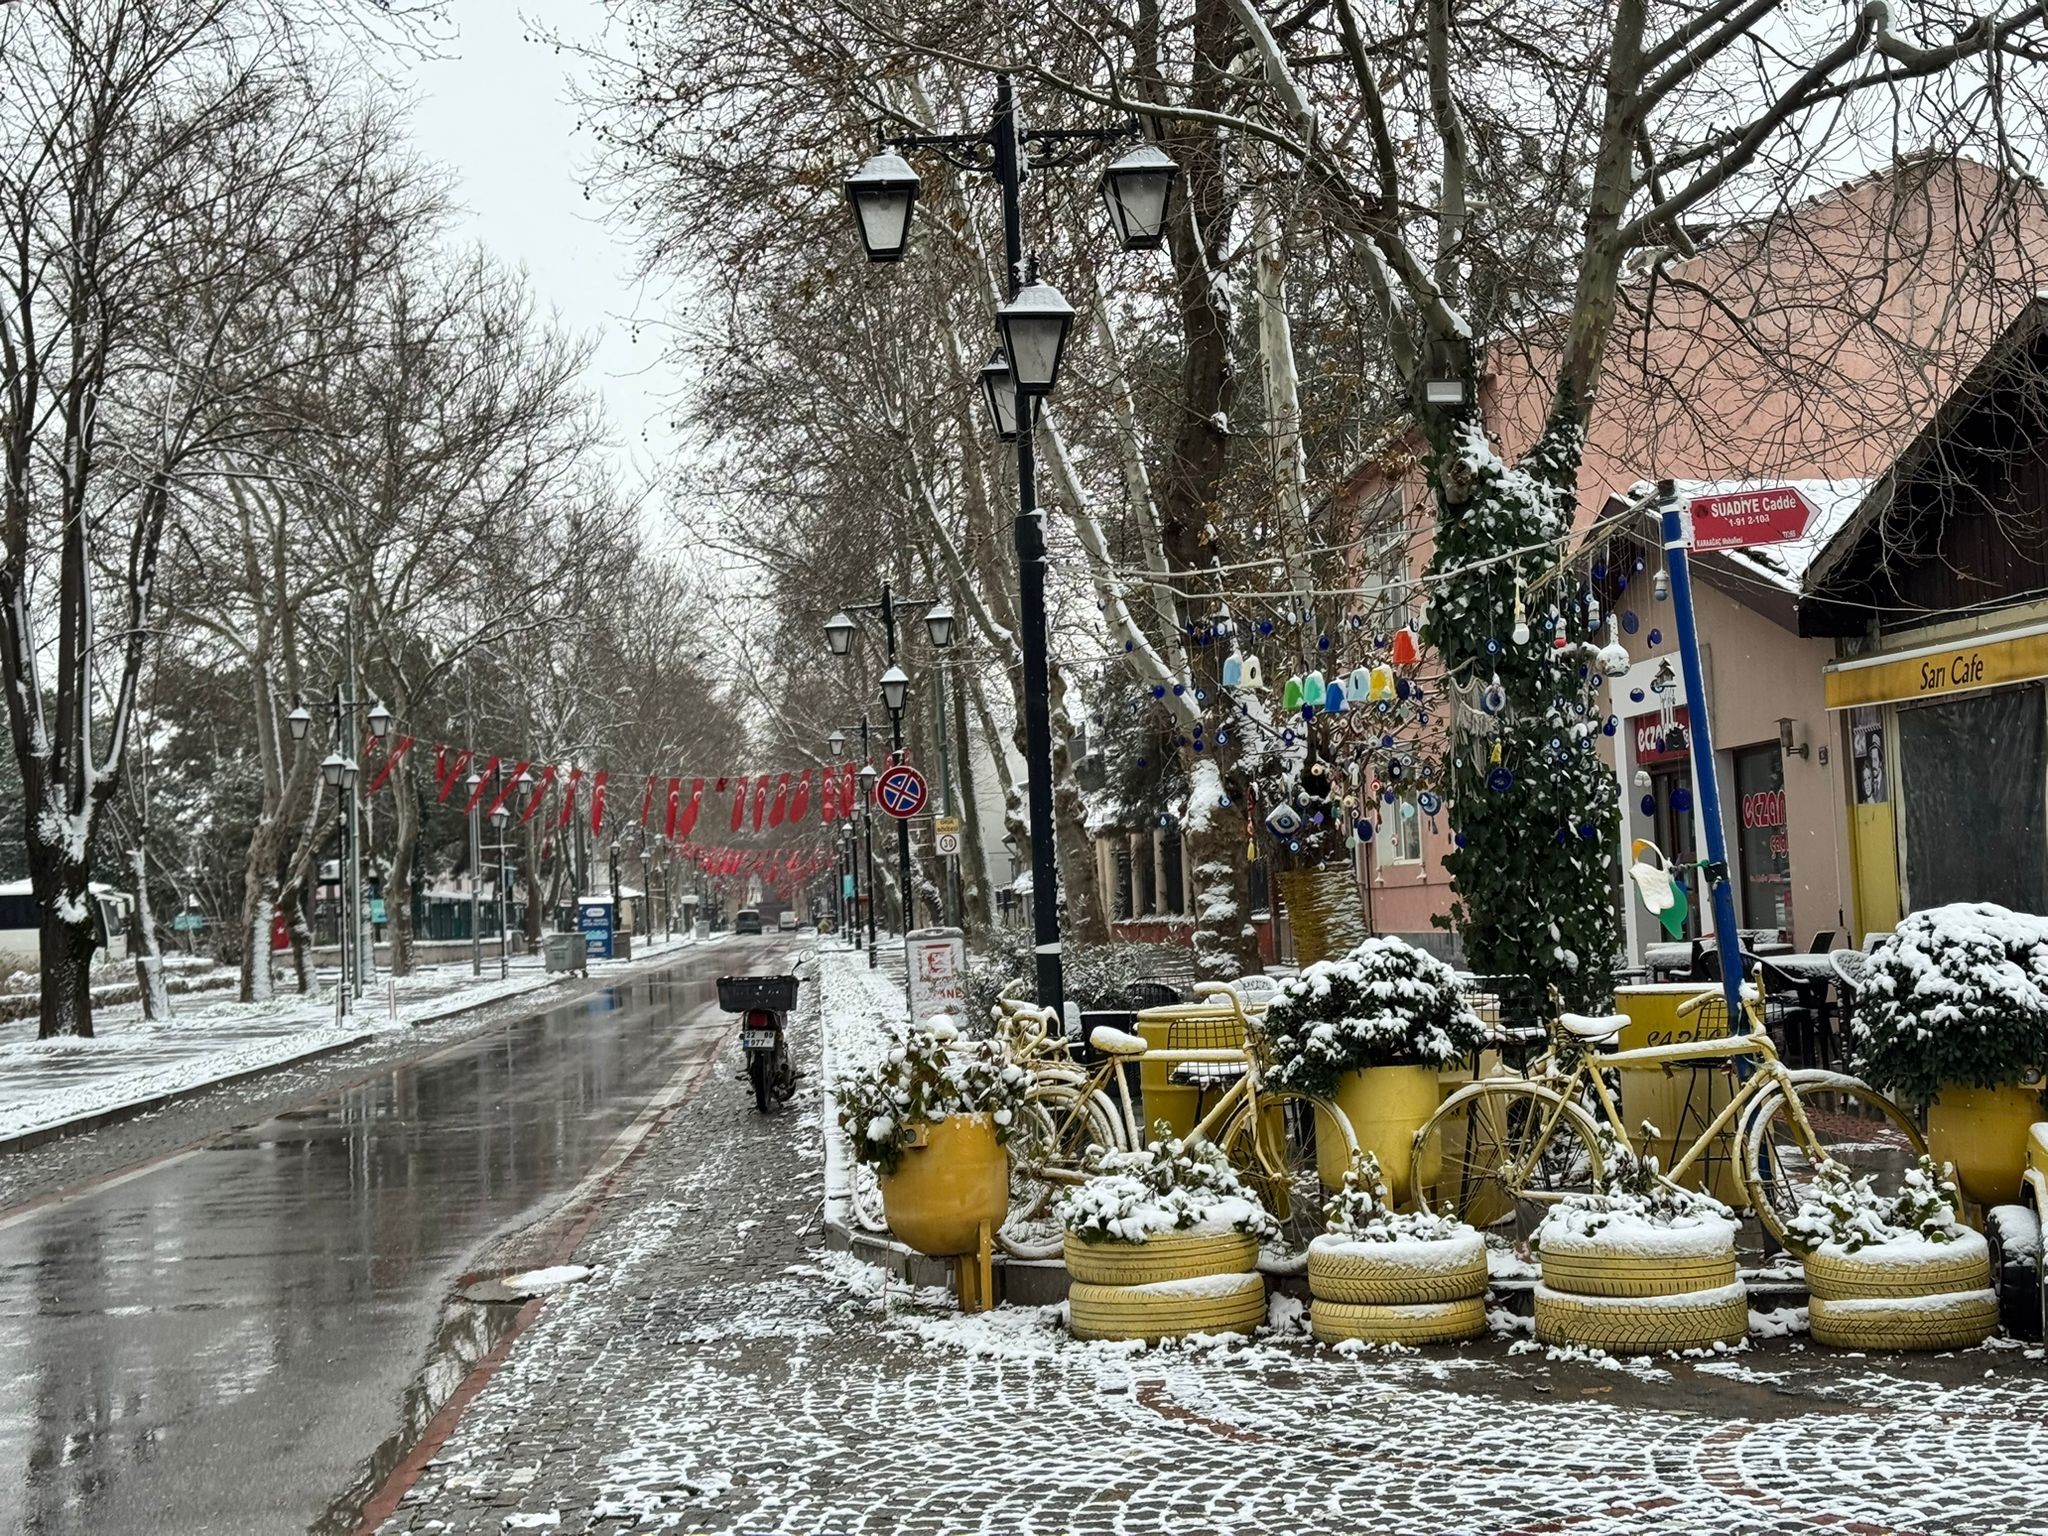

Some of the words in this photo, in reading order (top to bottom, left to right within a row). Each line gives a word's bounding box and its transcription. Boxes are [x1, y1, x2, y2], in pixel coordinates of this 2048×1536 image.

[1711, 497, 1760, 518] SUADİYE
[1762, 495, 1796, 512] Cadde
[1729, 517, 1745, 527] 1-91
[1748, 514, 1770, 525] 2-103
[1920, 662, 1946, 690] Sarı
[1951, 653, 1984, 685] Cafe
[943, 838, 954, 849] 30
